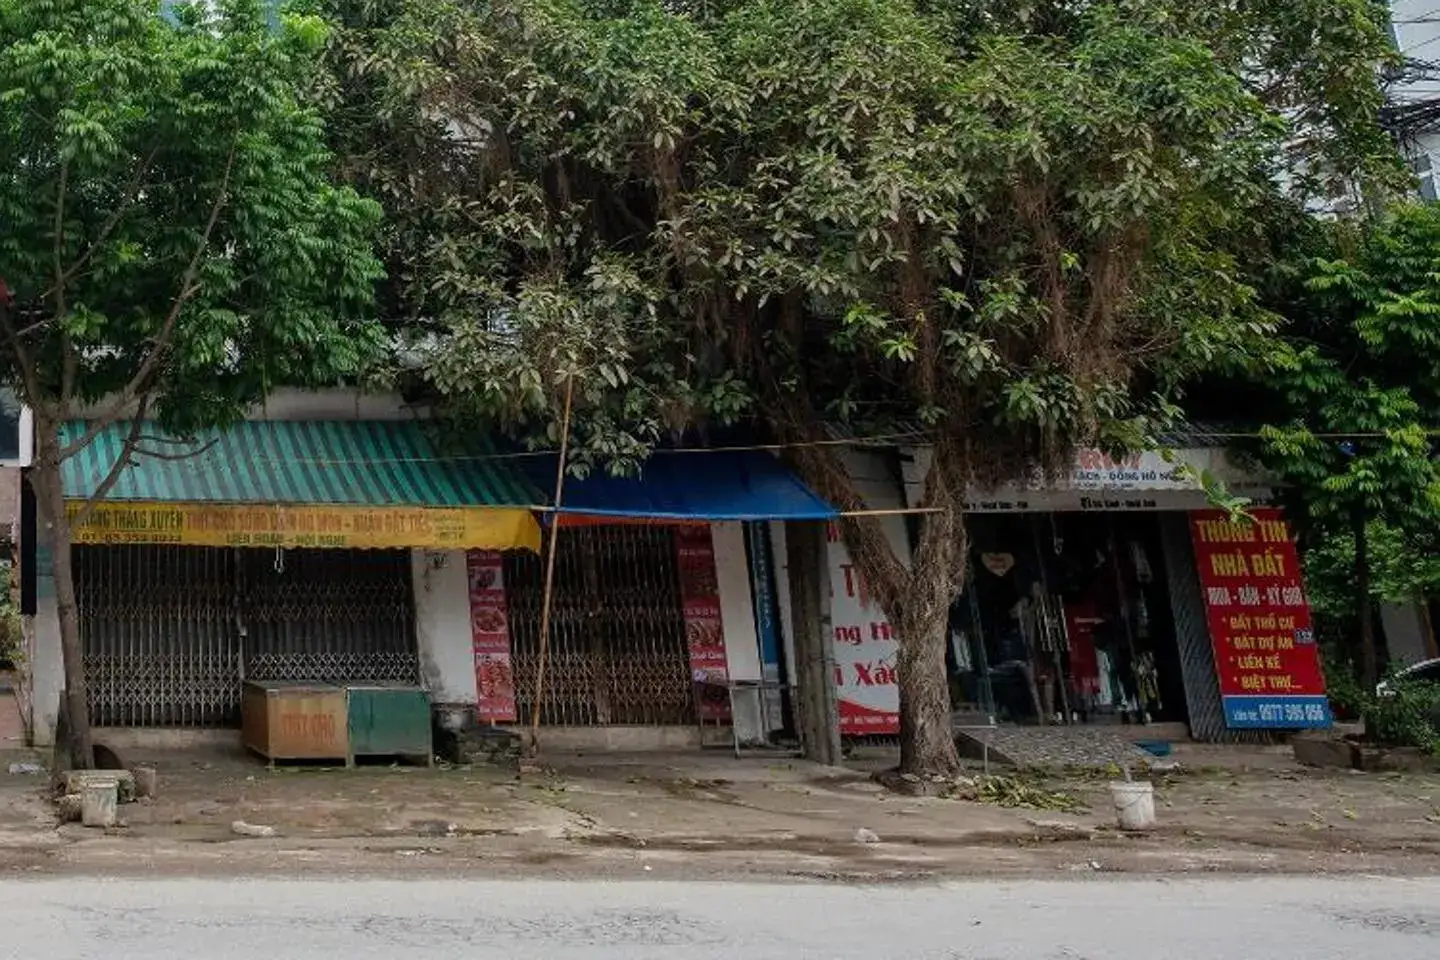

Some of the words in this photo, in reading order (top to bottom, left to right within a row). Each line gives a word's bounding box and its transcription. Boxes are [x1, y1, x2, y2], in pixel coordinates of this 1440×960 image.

[1196, 516, 1255, 542] THÔNG
[1258, 520, 1289, 542] TIN
[1210, 548, 1250, 576] NHÀ
[1251, 546, 1285, 576] ĐẤT
